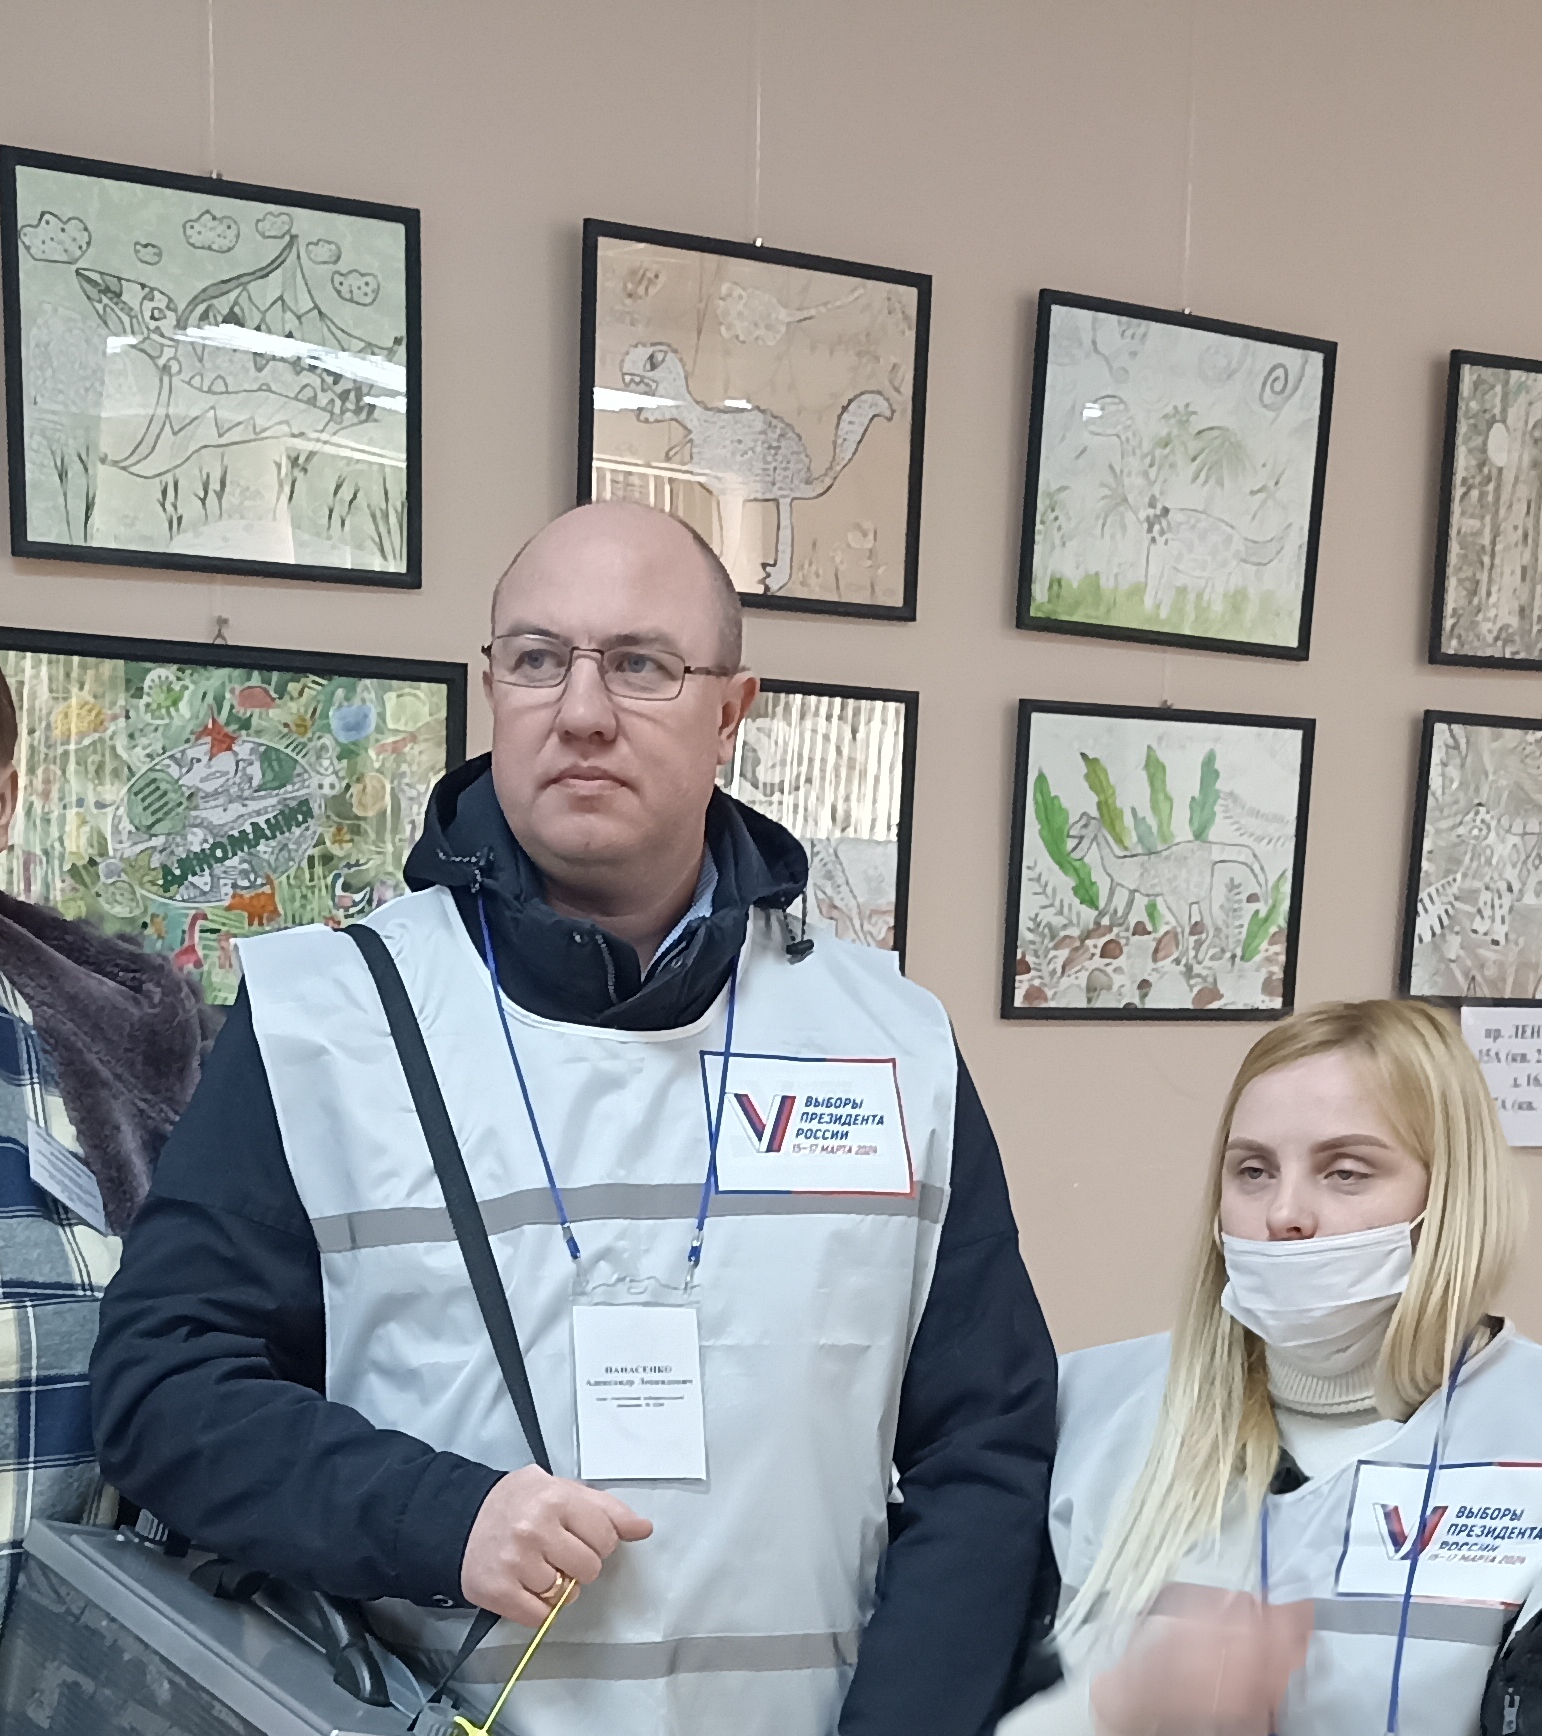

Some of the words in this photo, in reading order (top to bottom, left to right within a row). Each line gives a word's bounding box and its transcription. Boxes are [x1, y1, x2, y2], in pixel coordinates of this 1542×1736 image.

[161, 797, 314, 893] ДИНОМАНИЯ
[804, 1096, 865, 1109] ВЫБОРЫ
[799, 1111, 885, 1127] ПРЕЗИДЕНТА
[795, 1127, 850, 1141] РОССИИ
[820, 1144, 853, 1154] МАРТА
[1455, 1505, 1525, 1522] ВЫБОРЫ
[1438, 1540, 1501, 1553] РОССИИ
